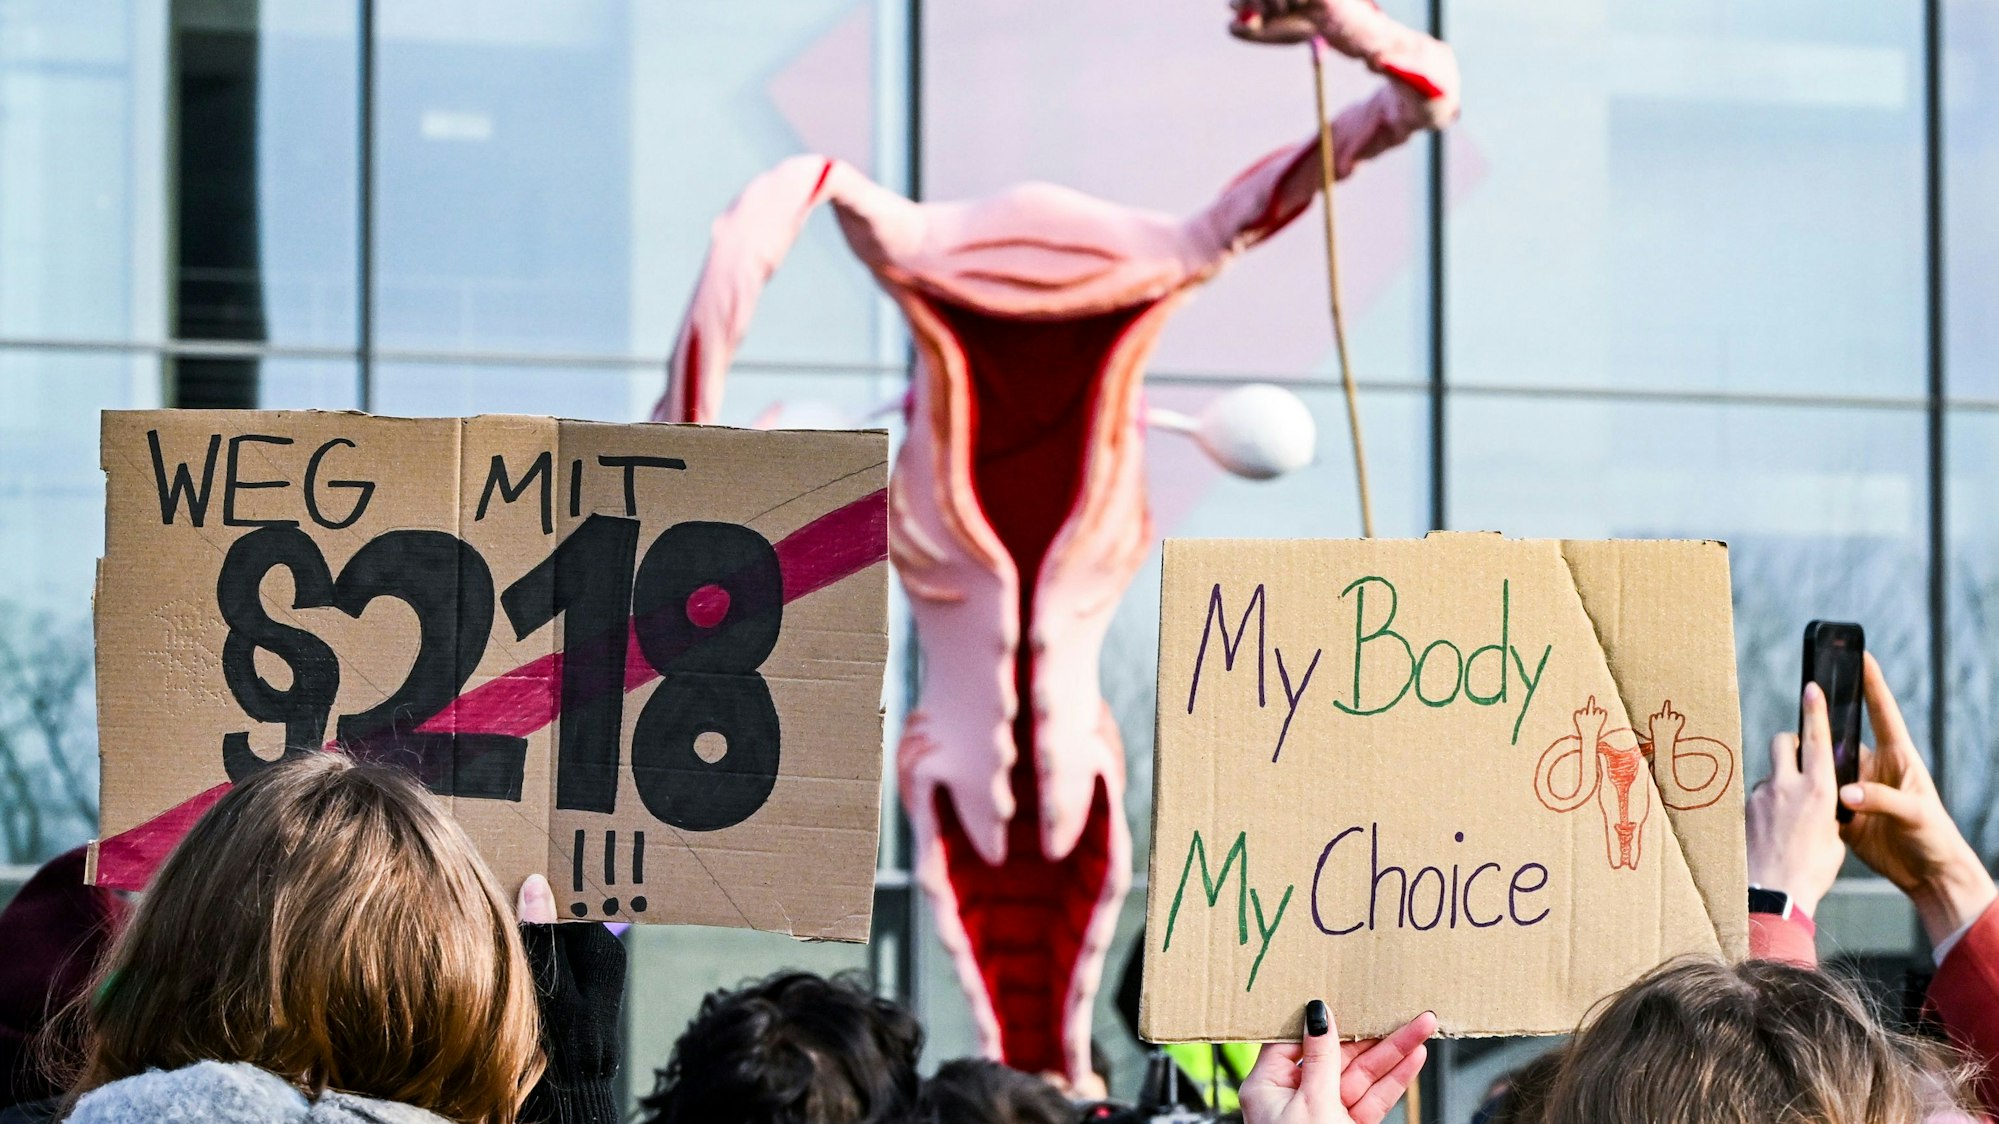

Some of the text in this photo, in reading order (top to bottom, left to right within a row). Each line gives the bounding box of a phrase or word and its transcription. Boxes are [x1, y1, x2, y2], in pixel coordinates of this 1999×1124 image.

[147, 429, 686, 534] WEG MIT
[217, 513, 783, 831] §218
[1187, 576, 1552, 762] My Body
[571, 829, 648, 918] !!!
[1163, 822, 1551, 992] My Choice
